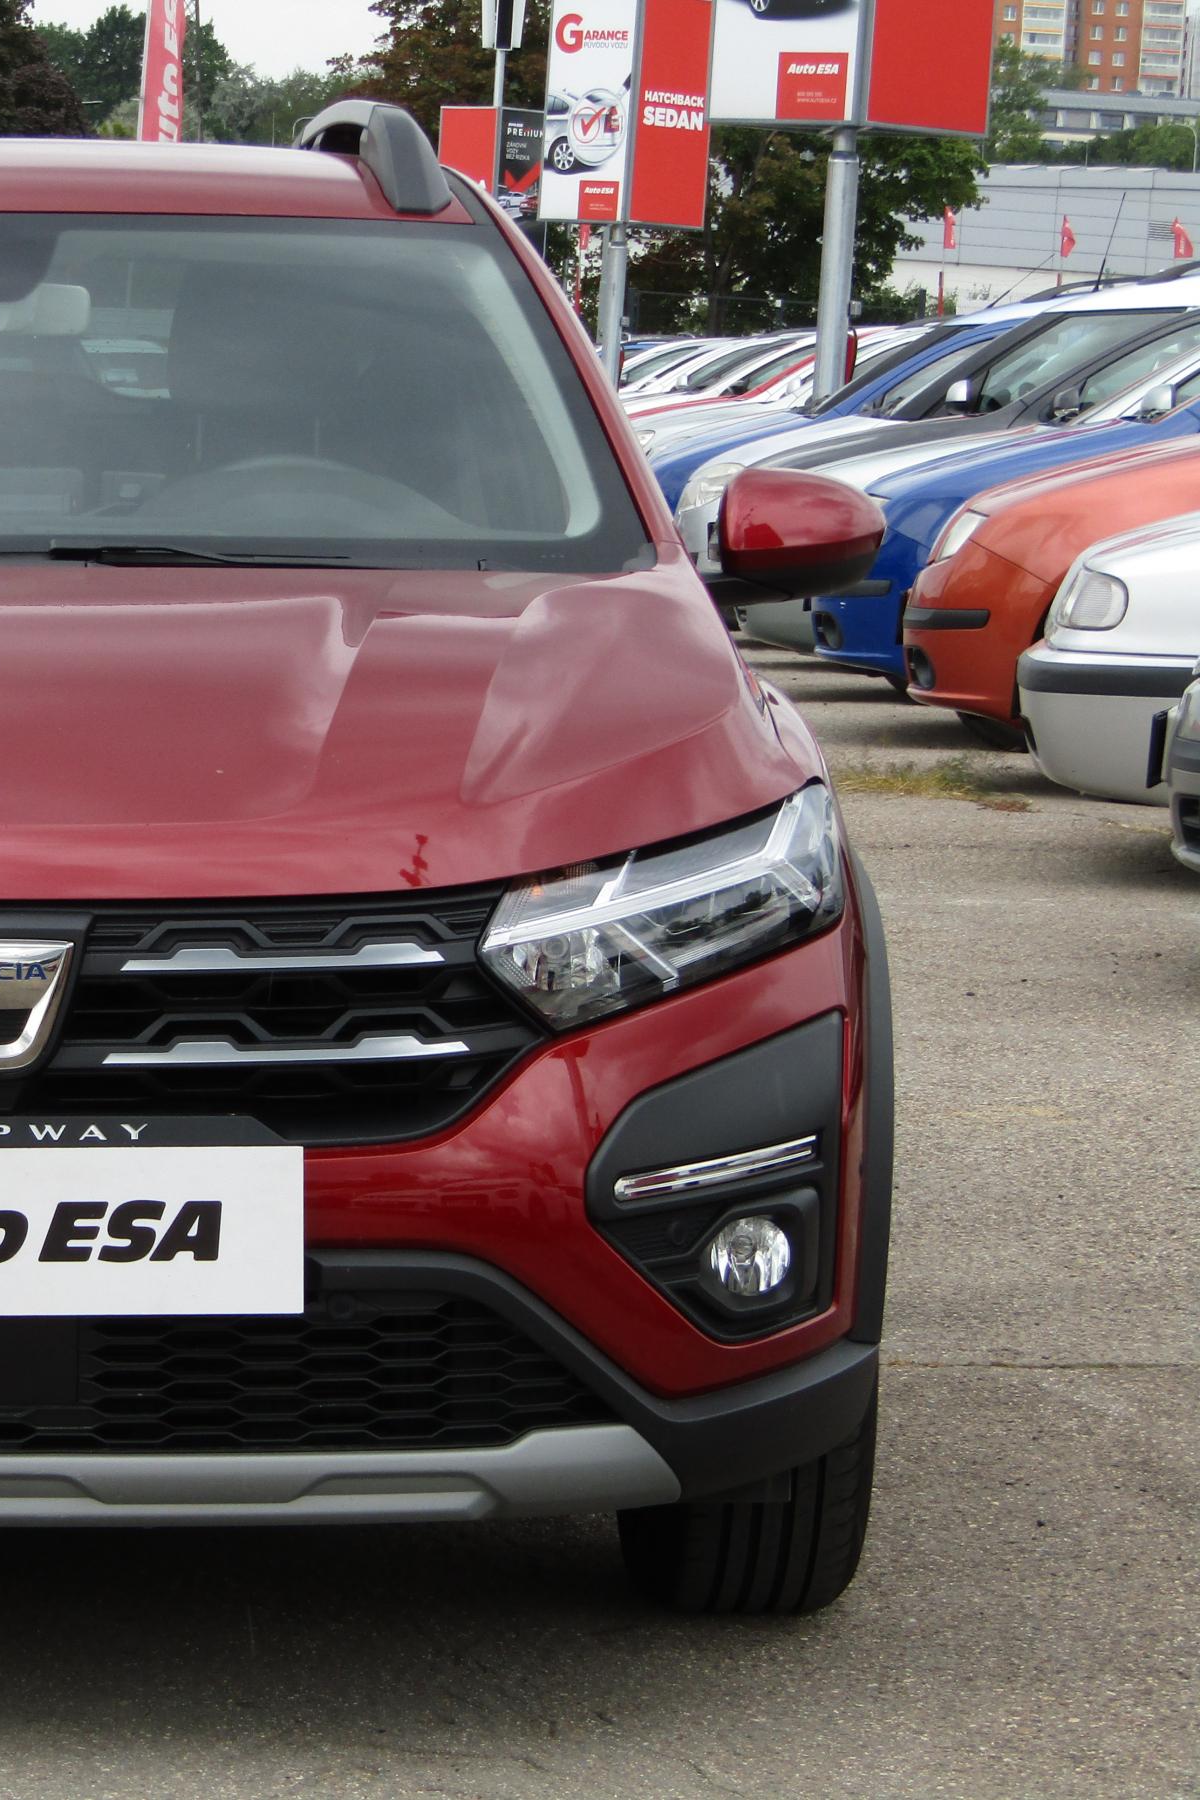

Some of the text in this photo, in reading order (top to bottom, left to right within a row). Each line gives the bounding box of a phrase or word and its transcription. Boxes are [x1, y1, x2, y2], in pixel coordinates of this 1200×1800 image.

[555, 13, 629, 54] GARANCE
[158, 0, 179, 142] uto ES
[787, 63, 840, 75] Auto ESA
[644, 90, 705, 108] HATCHBACK
[642, 106, 704, 132] SEDAN
[38, 1200, 222, 1263] ESA
